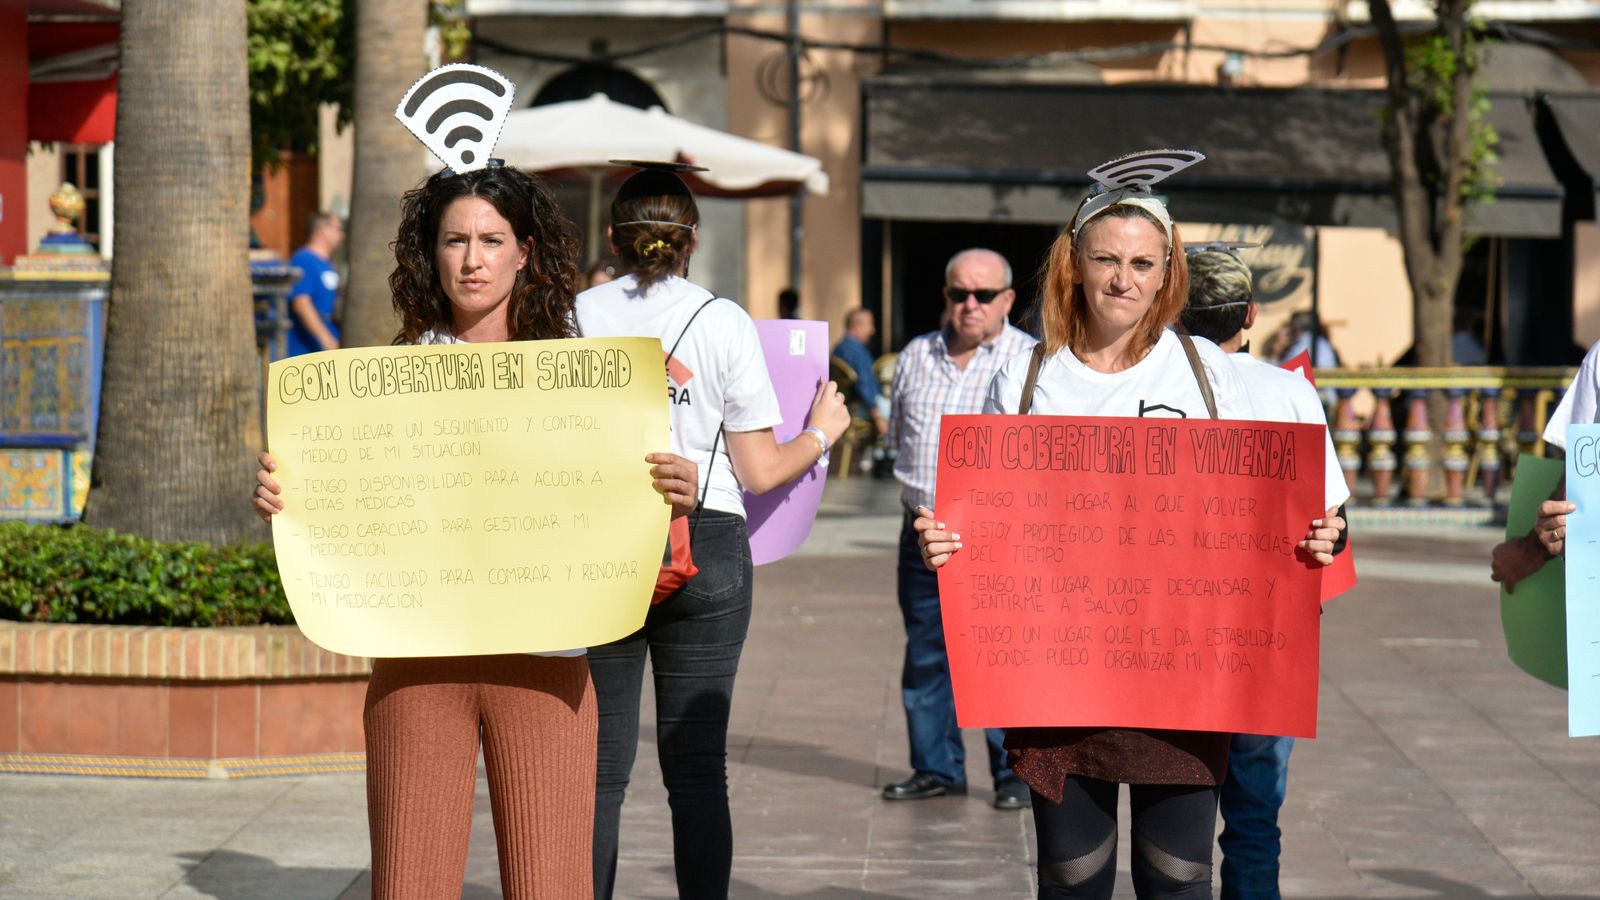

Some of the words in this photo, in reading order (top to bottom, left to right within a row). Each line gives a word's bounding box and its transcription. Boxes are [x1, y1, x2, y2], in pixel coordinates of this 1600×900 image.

[279, 360, 339, 405] CON
[349, 353, 484, 399] COBERTURA
[492, 353, 524, 390] EN
[302, 425, 342, 441] PUEDO
[352, 423, 393, 441] LLEVAR
[405, 422, 422, 438] UN
[433, 417, 508, 436] SEGUIMIENTO
[526, 416, 533, 432] Y
[542, 415, 601, 432] CONTROL
[359, 447, 375, 460] DE
[385, 447, 400, 459] MI
[945, 425, 992, 469] CON
[1000, 424, 1136, 475] COBERTURA
[1145, 427, 1176, 475] EN
[304, 478, 347, 493] TENGO
[360, 472, 472, 492] DISPONIBILIDAD
[485, 469, 519, 486] PARA
[535, 470, 585, 487] ACUDIR
[590, 470, 603, 485] A
[304, 497, 345, 511] CITAS
[968, 489, 1014, 507] TENGO
[1028, 491, 1047, 507] UN
[1065, 492, 1112, 512] HOGAR
[1124, 494, 1139, 512] AL
[1155, 494, 1184, 513] QUE
[1200, 496, 1257, 517] VOLVER
[308, 524, 349, 539] TENGO
[357, 520, 428, 538] CAPACIDAD
[442, 518, 473, 534] PARA
[483, 514, 560, 532] GESTIONAR
[573, 513, 590, 529] MI
[970, 521, 1012, 541] ESTOY
[1023, 524, 1103, 544] PROTEGIDO
[1119, 527, 1136, 545] DE
[1148, 528, 1176, 546] LAS
[970, 545, 996, 562] DEL
[1013, 545, 1064, 563] TIEMPO
[309, 572, 350, 589] TENGO
[440, 568, 475, 585] PARA
[488, 565, 551, 585] COMPRAR
[565, 565, 572, 582] Y
[582, 560, 639, 581] RENOVAR
[970, 574, 1015, 593] TENGO
[1025, 577, 1041, 593] UN
[1051, 576, 1093, 595] LUGAR
[1107, 577, 1152, 596] DONDE
[1167, 577, 1252, 597] DESCANSAR
[1265, 578, 1276, 599] Y
[311, 592, 327, 606] MI
[971, 593, 1045, 612] SENTIRME
[1061, 598, 1070, 612] A
[1085, 598, 1137, 615] SALVO
[970, 625, 1012, 644] TENGO
[1022, 625, 1040, 644] UN
[1053, 626, 1092, 644] LUGAR
[1104, 625, 1133, 644] QUE
[1140, 628, 1161, 647] ME
[1175, 628, 1192, 647] DA
[1206, 627, 1287, 650] ESTABILIDAD
[975, 650, 982, 666] Y
[987, 650, 1034, 666] DONDE
[1047, 648, 1089, 666] PUEDO
[1104, 650, 1176, 671] ORGANIZAR
[1186, 652, 1201, 671] MI
